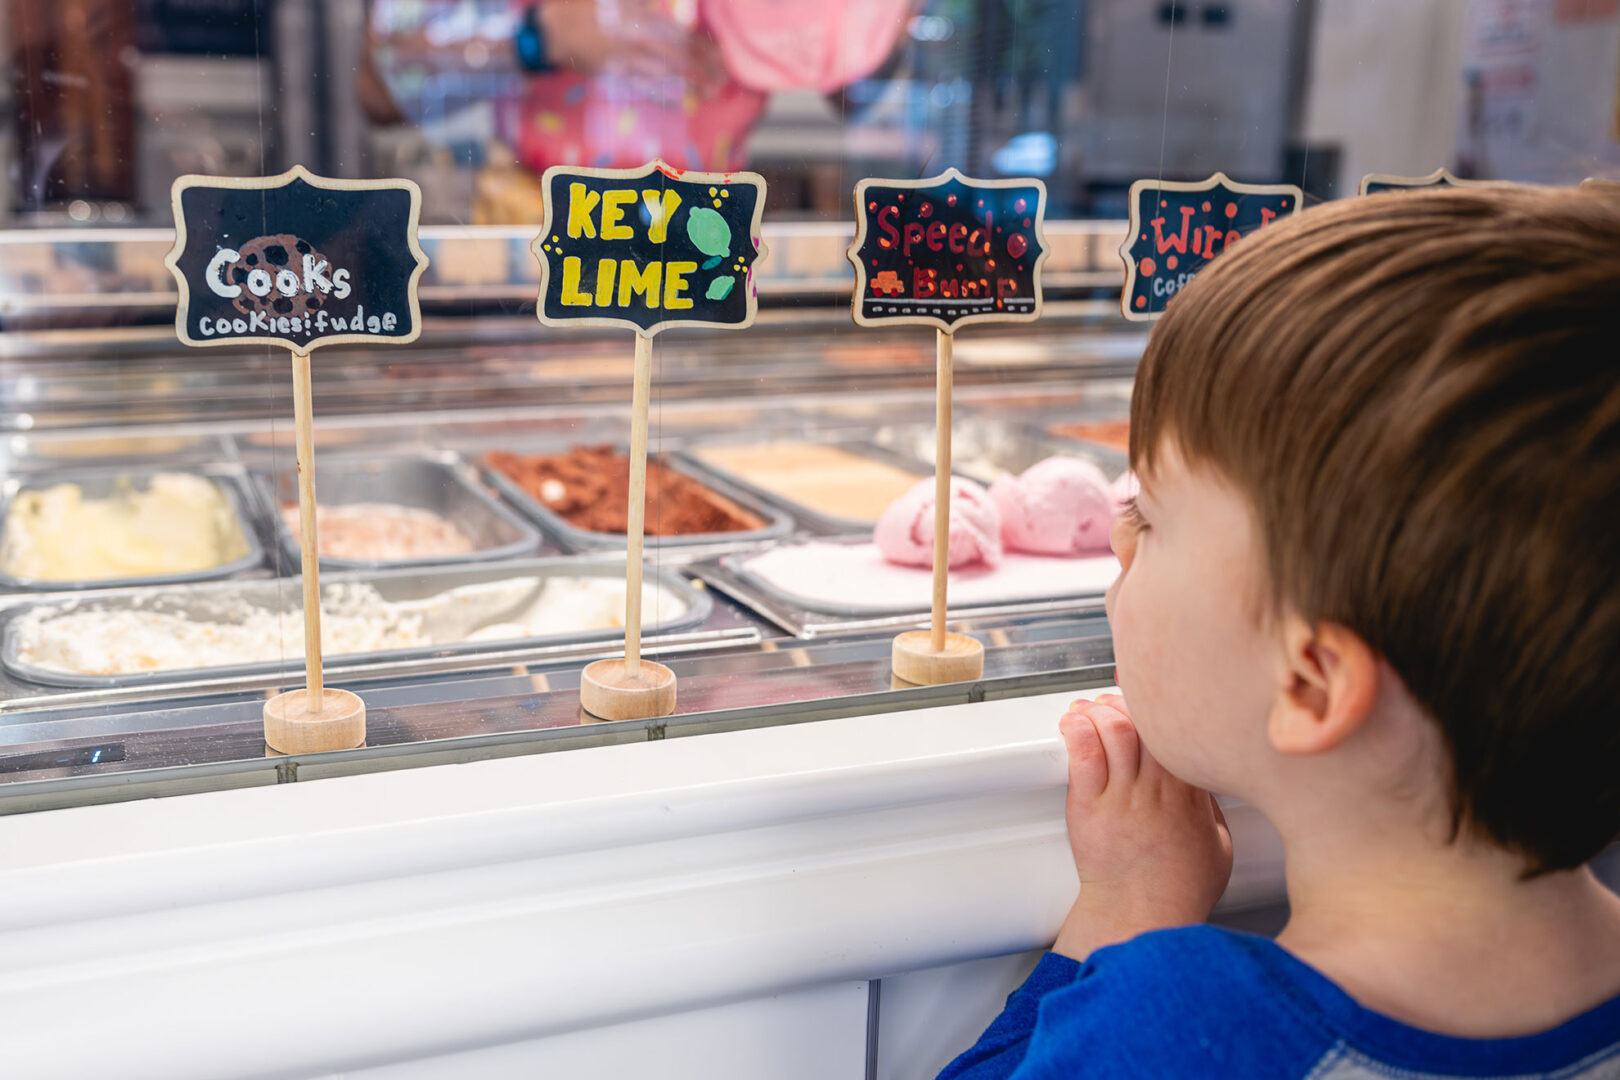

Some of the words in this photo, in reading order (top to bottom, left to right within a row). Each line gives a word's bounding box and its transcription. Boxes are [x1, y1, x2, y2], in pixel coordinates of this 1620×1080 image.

[567, 182, 682, 243] KEY
[877, 205, 993, 257] Speed
[1151, 206, 1276, 260] Wire
[205, 248, 351, 299] Cooks
[561, 256, 698, 309] LIME
[913, 266, 1017, 308] Bump
